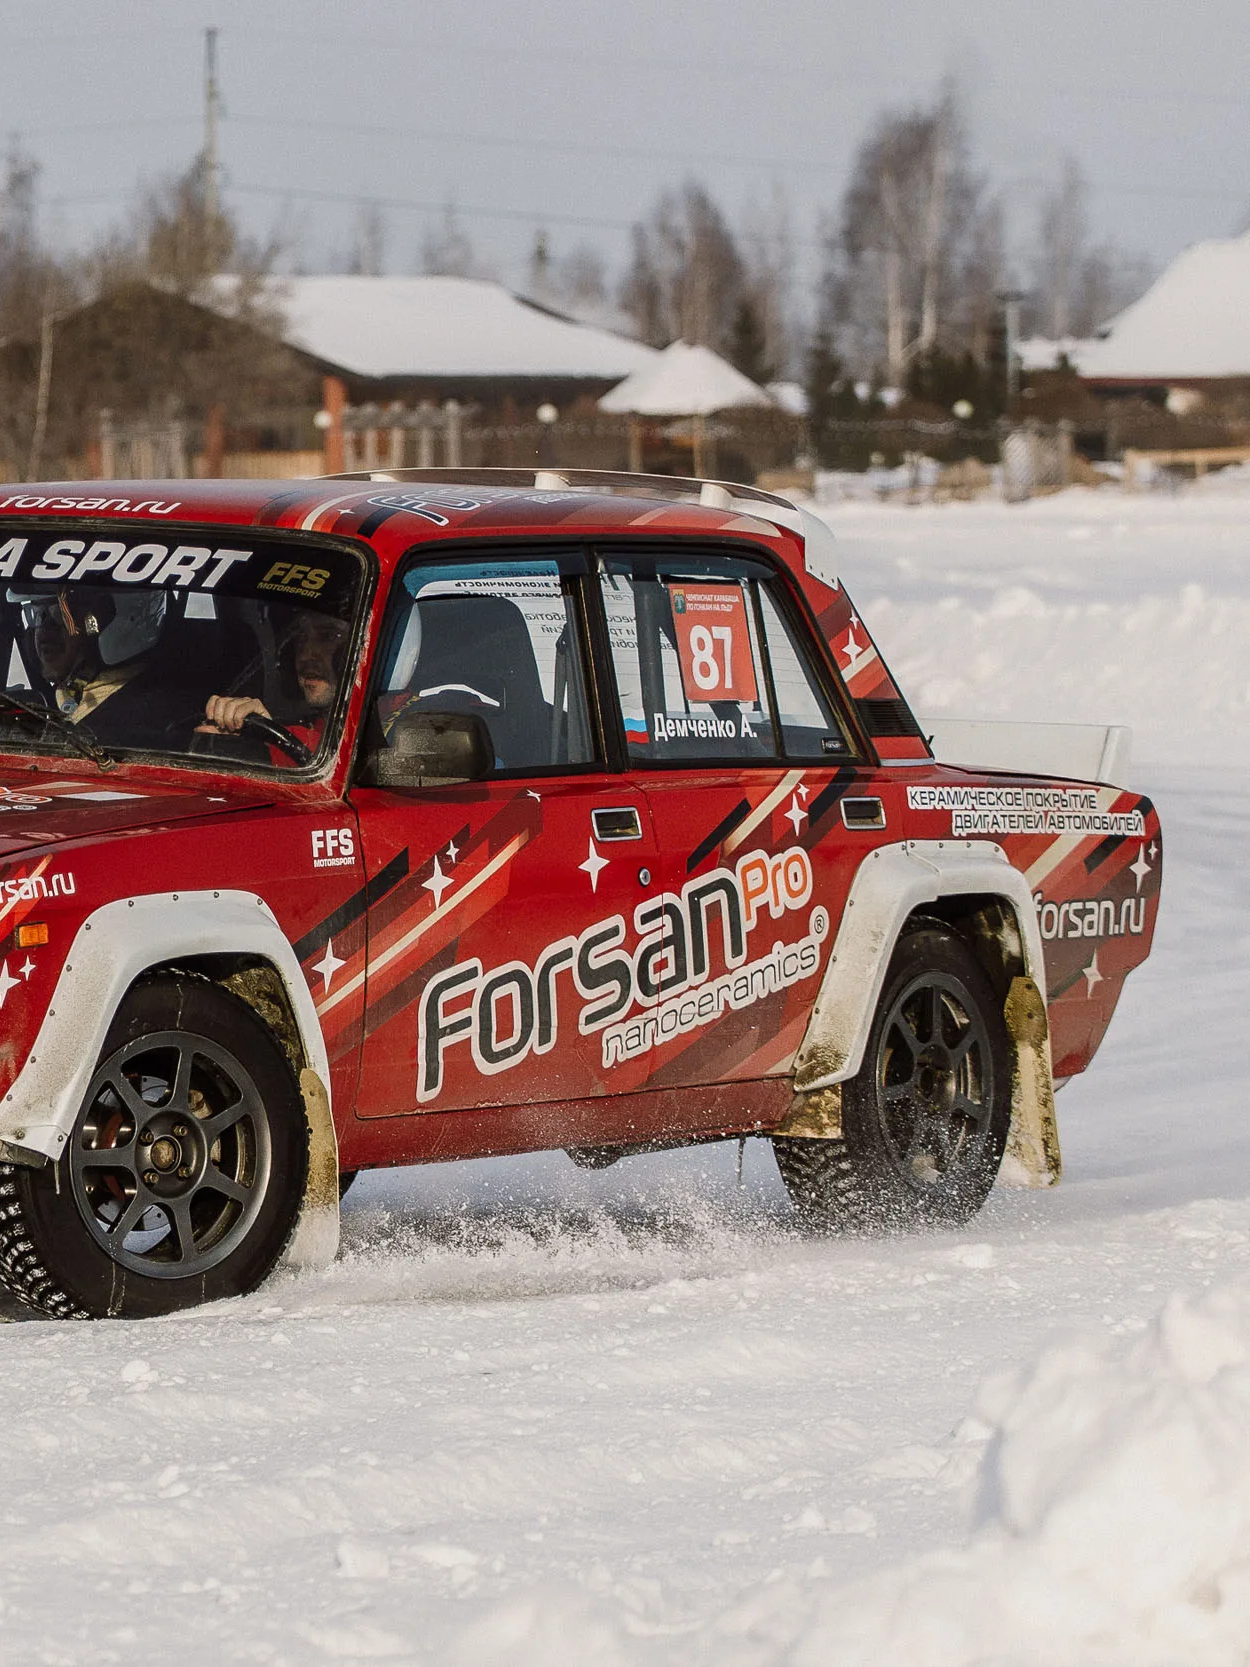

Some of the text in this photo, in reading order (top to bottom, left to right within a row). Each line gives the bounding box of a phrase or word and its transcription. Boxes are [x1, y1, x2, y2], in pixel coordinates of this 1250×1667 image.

[32, 540, 254, 588] SPORT
[262, 561, 331, 590] FFS
[256, 581, 322, 599] MOTORSPORT
[689, 624, 733, 691] 87
[653, 713, 736, 742] Демченко
[909, 789, 1098, 811] КЕРАМИЧЕСКОЕ ПОКРЫТИЕ
[953, 811, 1144, 833] ДВИГАТЕЛЕЙ АВТОМОБИЛЕЙ
[311, 828, 354, 858] FFS
[313, 856, 356, 868] MOTORSPORT
[1033, 890, 1146, 939] forsan.ru
[604, 942, 817, 1064] nanoceramics
